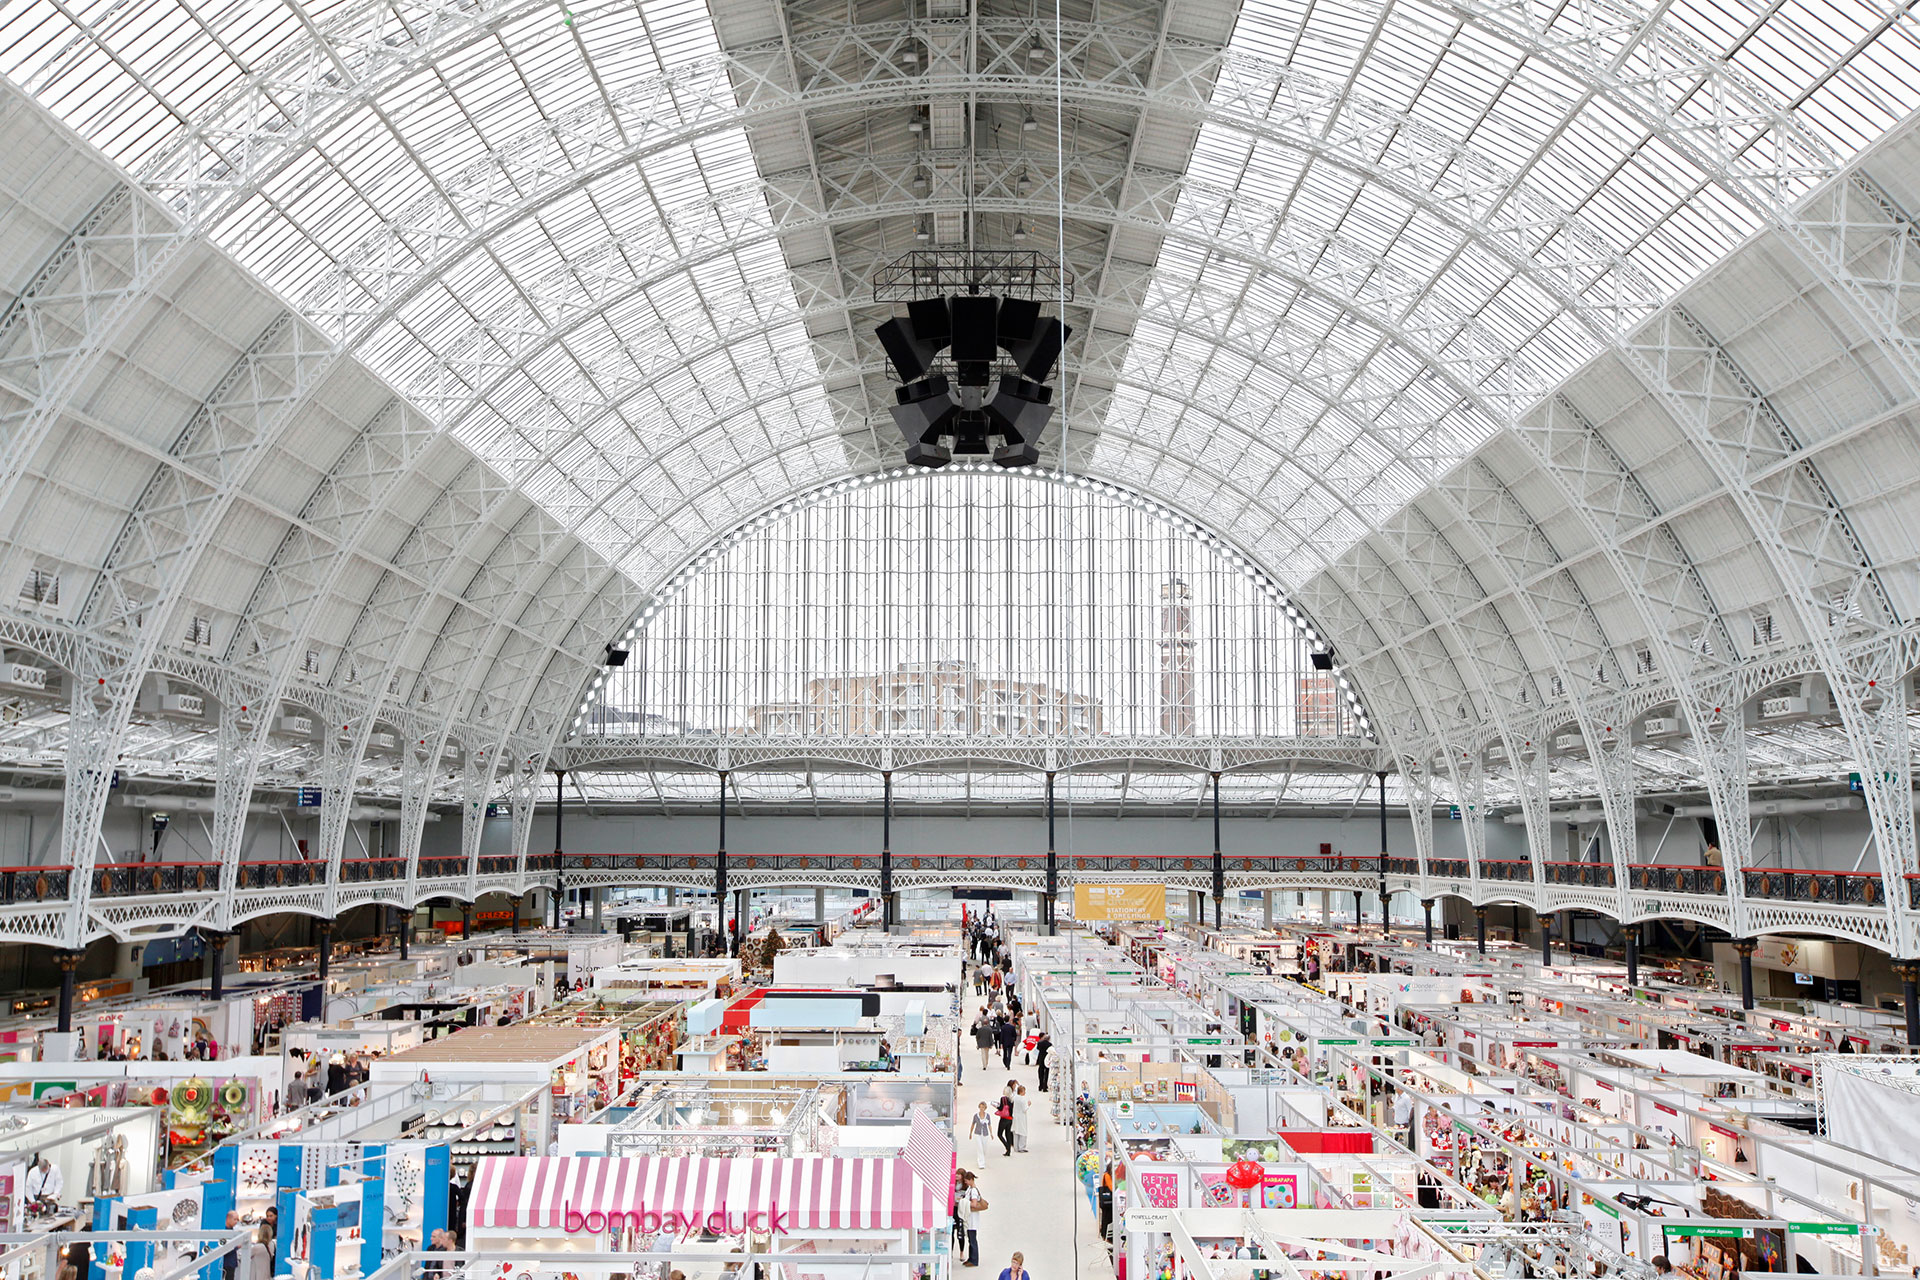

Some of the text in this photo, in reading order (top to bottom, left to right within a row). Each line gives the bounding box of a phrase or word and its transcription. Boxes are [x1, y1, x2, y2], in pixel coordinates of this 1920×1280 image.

[1107, 886, 1125, 898] top
[476, 911, 514, 919] CRUSSH
[1143, 1175, 1177, 1184] PETIT
[1149, 1187, 1177, 1196] OUR
[1151, 1199, 1177, 1208] ARIS
[565, 1200, 788, 1244] bombay duck
